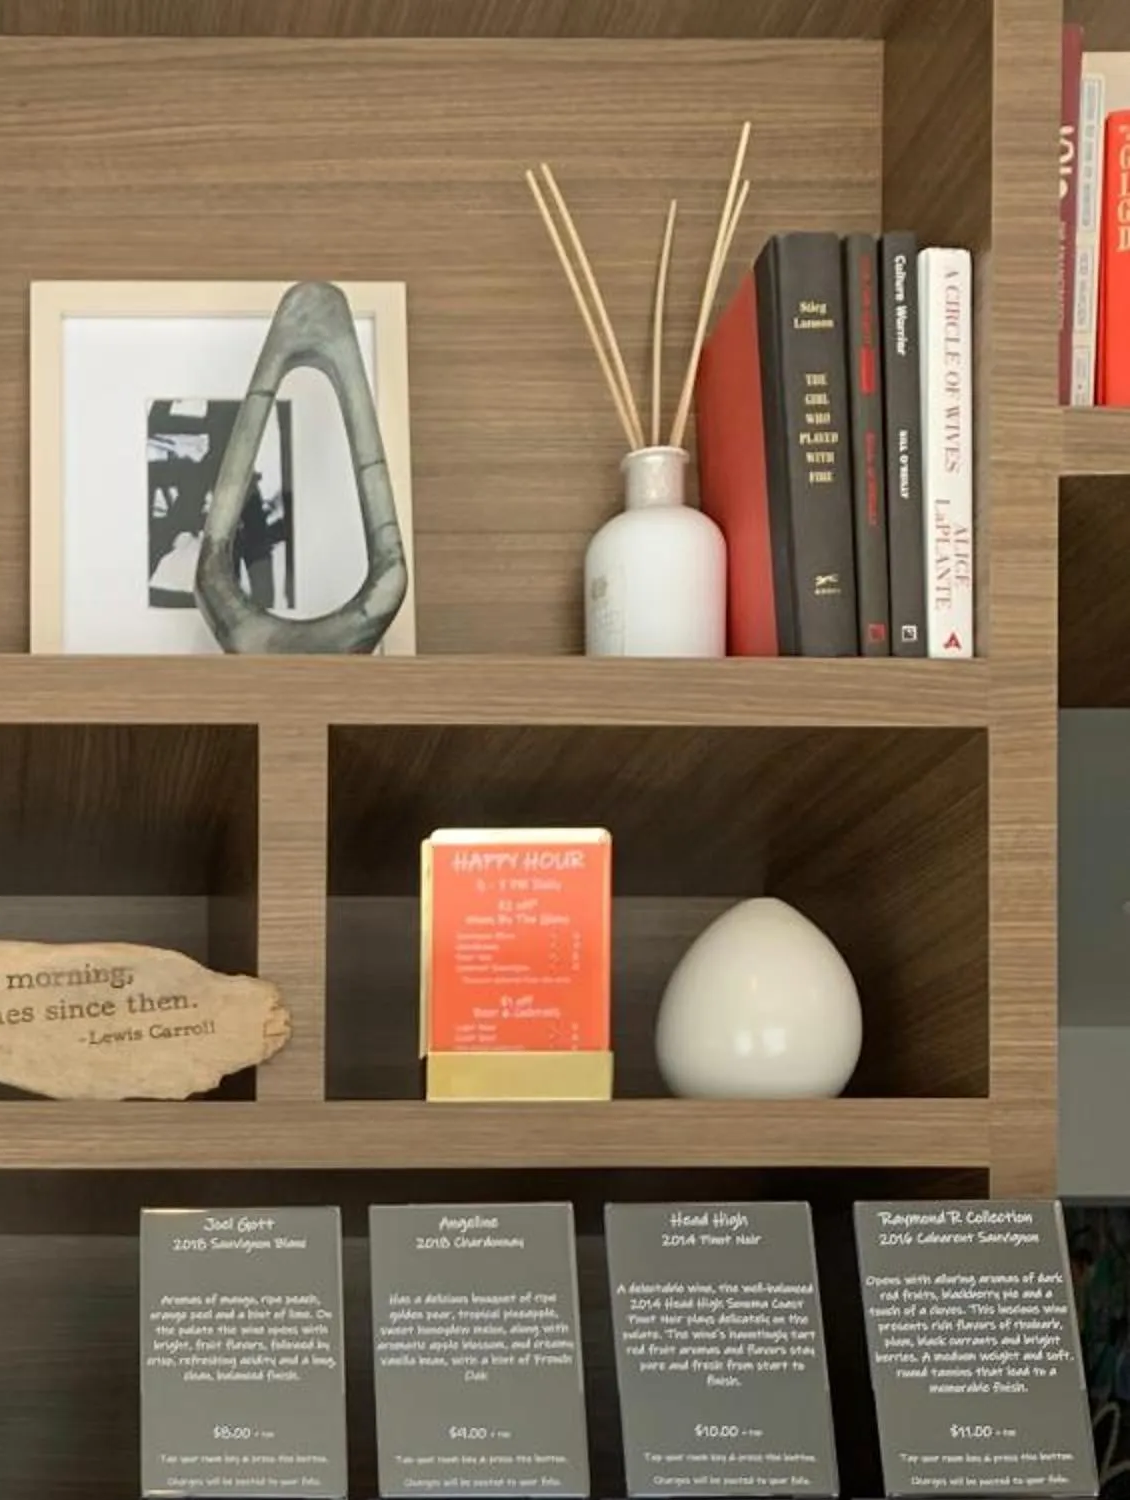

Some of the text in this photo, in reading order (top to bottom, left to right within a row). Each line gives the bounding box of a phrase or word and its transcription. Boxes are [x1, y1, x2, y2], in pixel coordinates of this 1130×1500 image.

[799, 302, 827, 316] Stieg
[894, 255, 908, 356] Culture Warrior
[793, 317, 834, 329] Larsson
[945, 267, 960, 473] A CIRCLE OF WIVES
[805, 373, 827, 386] THE
[805, 393, 829, 406] GIRL
[805, 412, 831, 425] WHO
[799, 432, 838, 444] PLAYED
[806, 451, 834, 464] WITH
[899, 431, 909, 499] BILL O'REILLY
[809, 471, 834, 484] FIRE
[934, 499, 951, 610] LaPLANTE
[953, 524, 969, 587] ALICE
[451, 852, 586, 870] HAPPY HOUR
[6, 964, 135, 992] morning,
[45, 998, 116, 1022] since
[127, 992, 198, 1015] then.
[150, 1020, 216, 1040] Carroll
[203, 1217, 276, 1232] Joel Gott
[439, 1216, 499, 1232] Angeline
[670, 1213, 748, 1230] Head High
[878, 1210, 945, 1228] Raymond
[966, 1210, 1032, 1224] Collection
[173, 1238, 206, 1250] 2018
[211, 1238, 271, 1253] Sauvignon
[416, 1235, 524, 1249] 2018 Chardonnay
[701, 1235, 732, 1246] Pinot
[736, 1235, 762, 1246] Noir
[880, 1231, 1039, 1246] 2016 Cabernet Sauvignon
[694, 1424, 738, 1438] $10.00
[950, 1424, 992, 1438] $11.00
